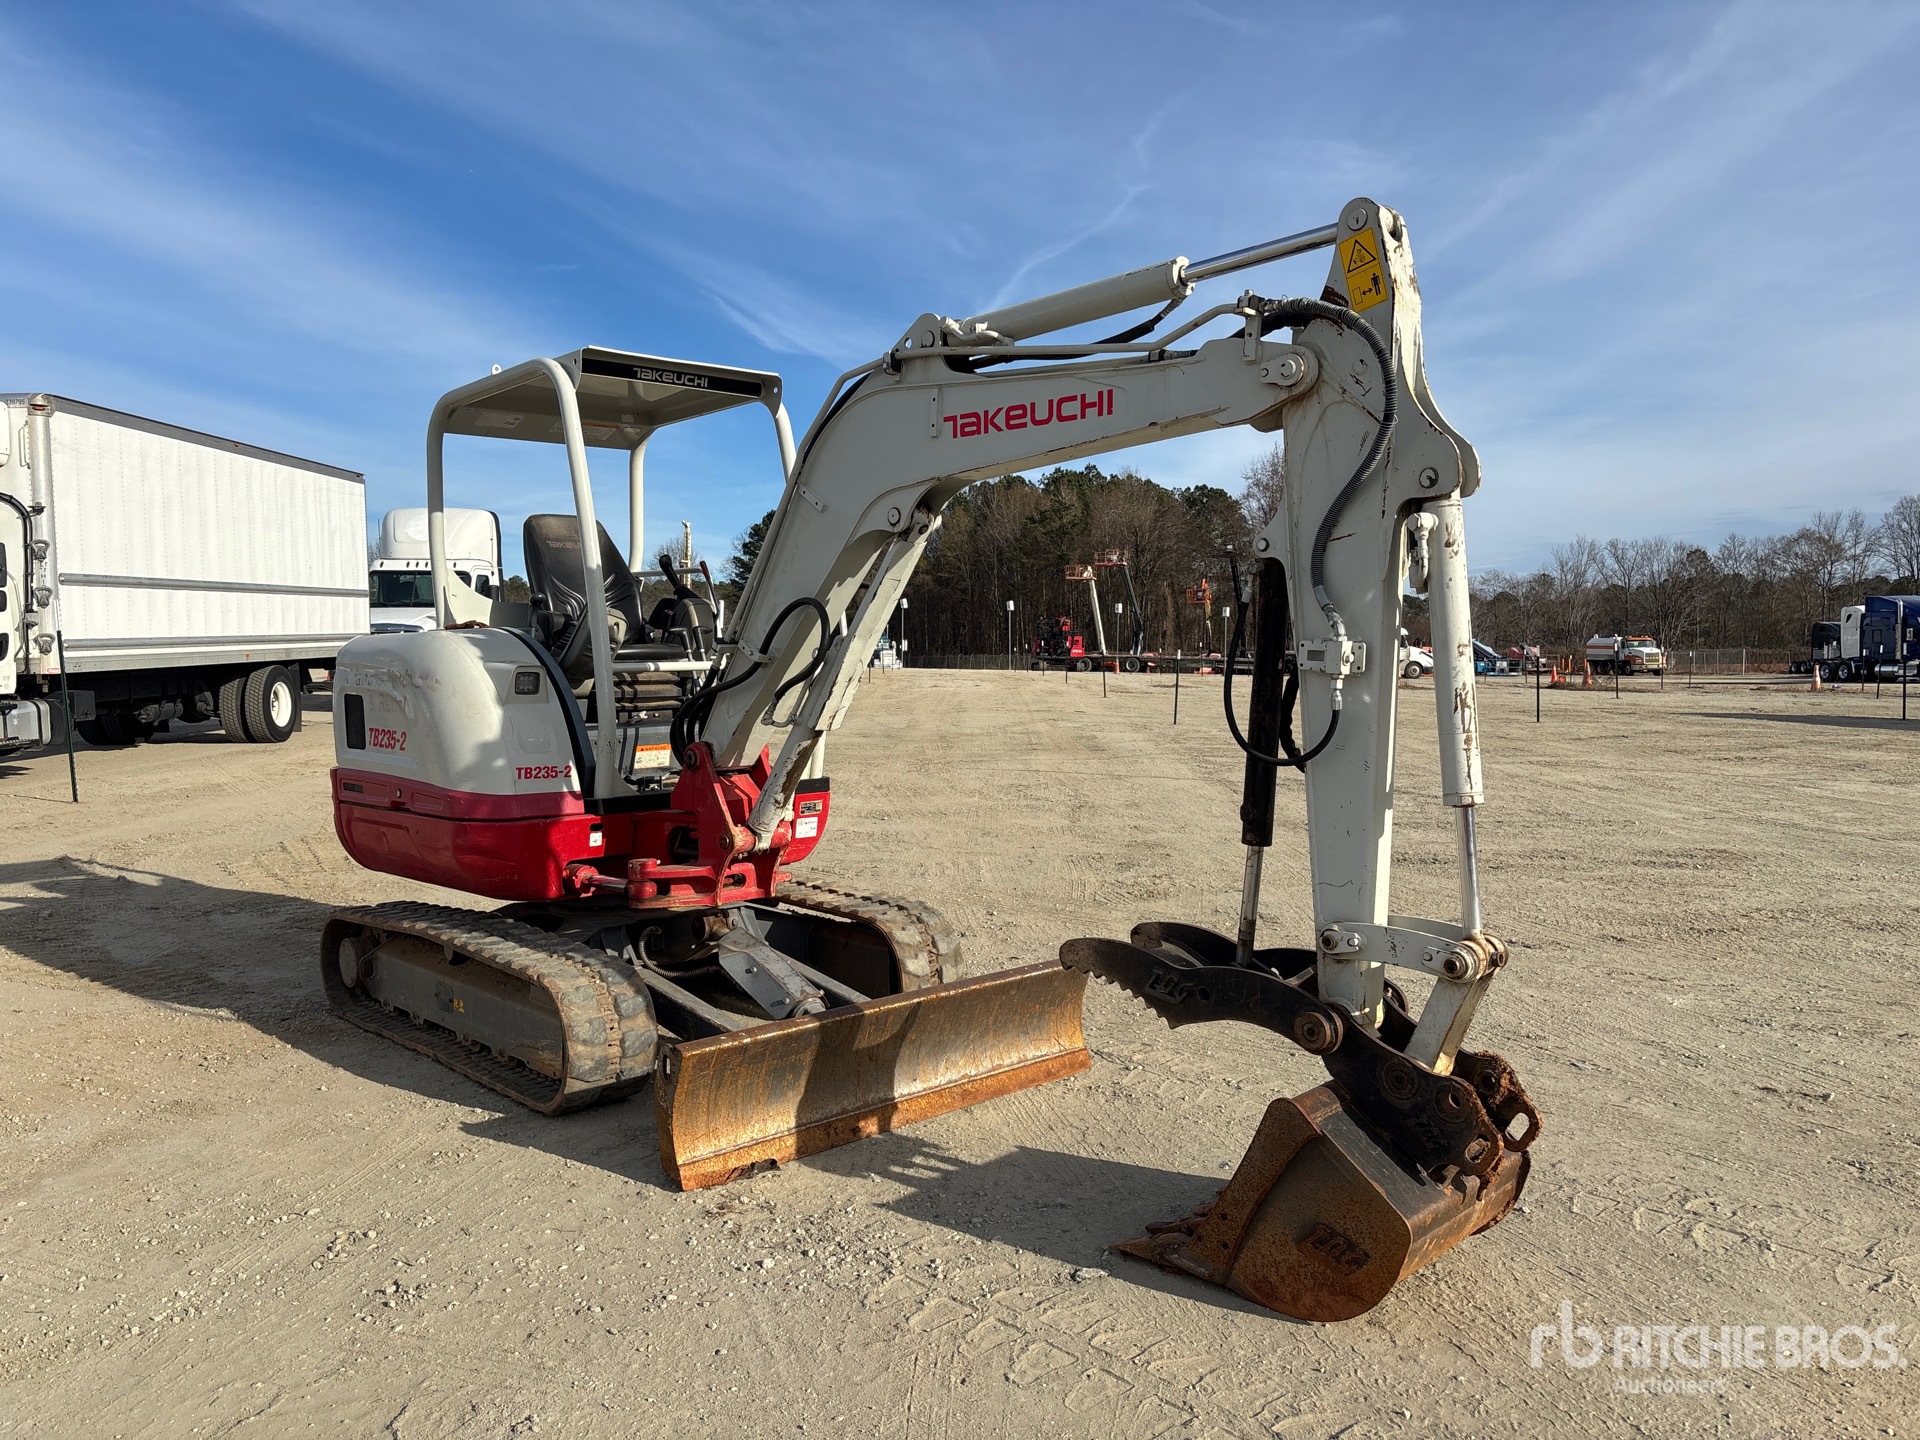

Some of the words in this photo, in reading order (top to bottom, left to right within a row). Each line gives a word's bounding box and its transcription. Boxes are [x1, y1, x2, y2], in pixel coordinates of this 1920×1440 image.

[633, 367, 708, 388] TAKEUCHI
[943, 389, 1114, 439] TAKEUCHI
[369, 727, 407, 751] TB235-2
[515, 765, 573, 780] TB235-2
